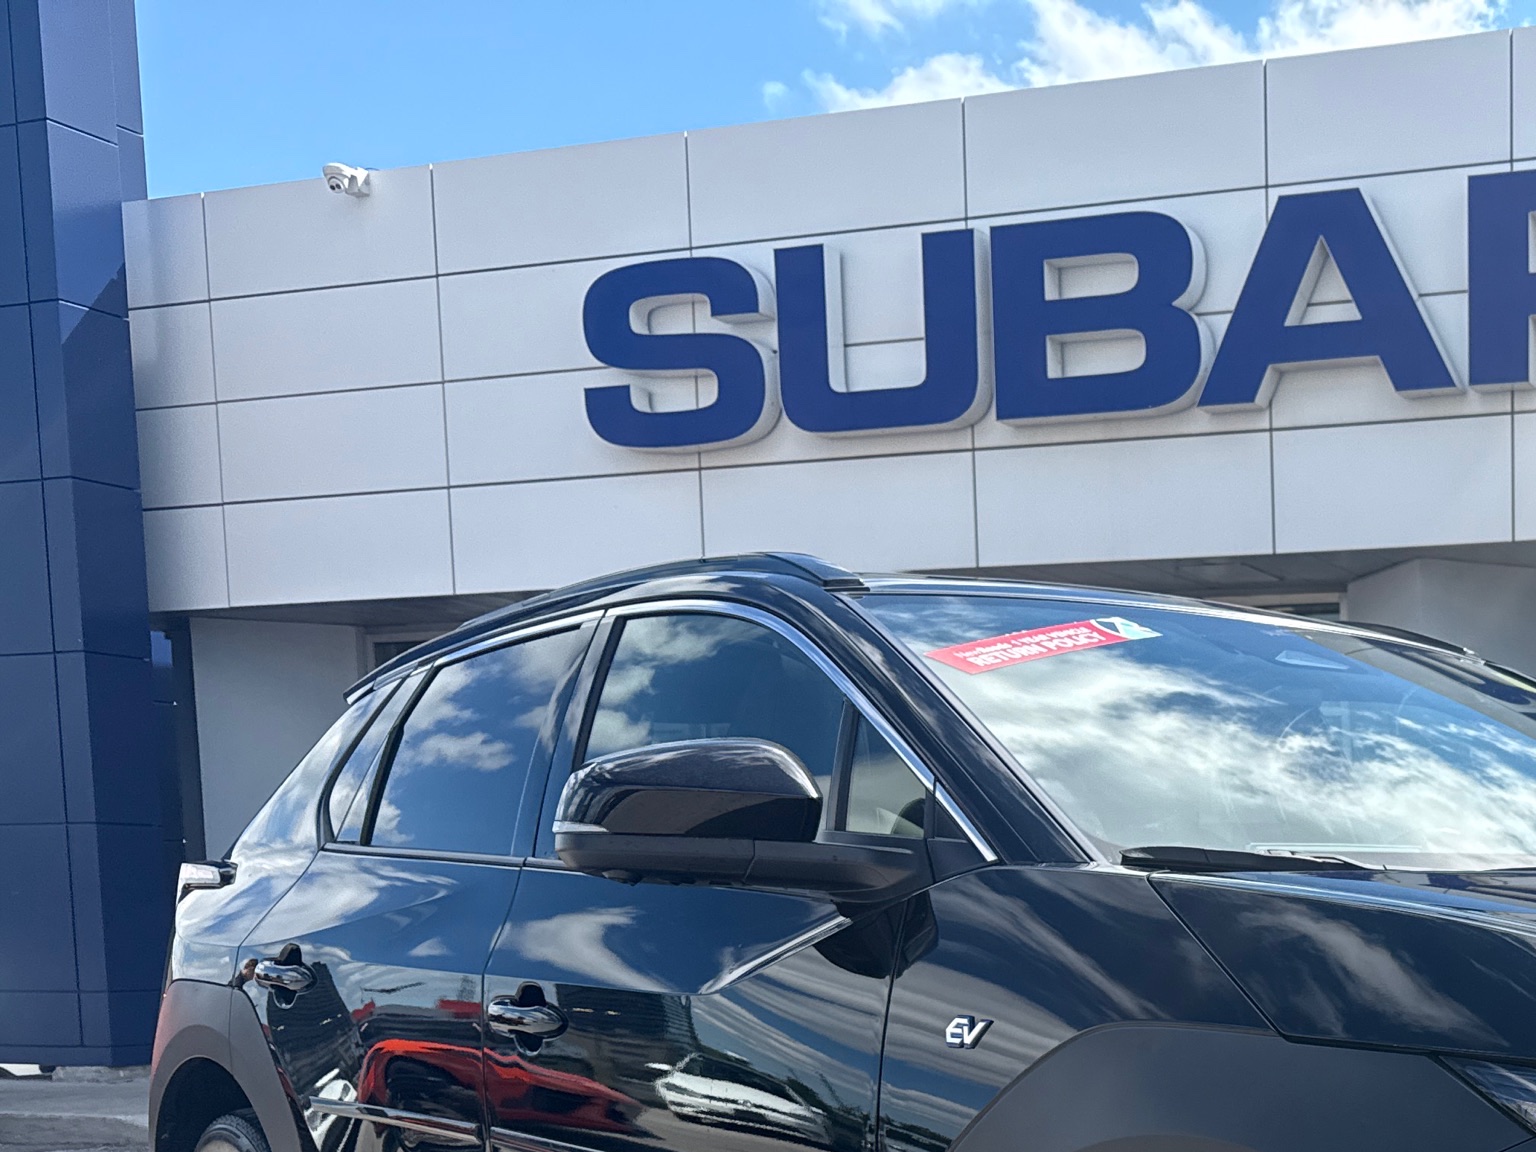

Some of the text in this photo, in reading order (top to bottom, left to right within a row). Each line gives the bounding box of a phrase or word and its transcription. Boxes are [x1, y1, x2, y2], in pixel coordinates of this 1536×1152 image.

[967, 632, 1106, 666] RETURN POLICY
[946, 1016, 993, 1048] EV
